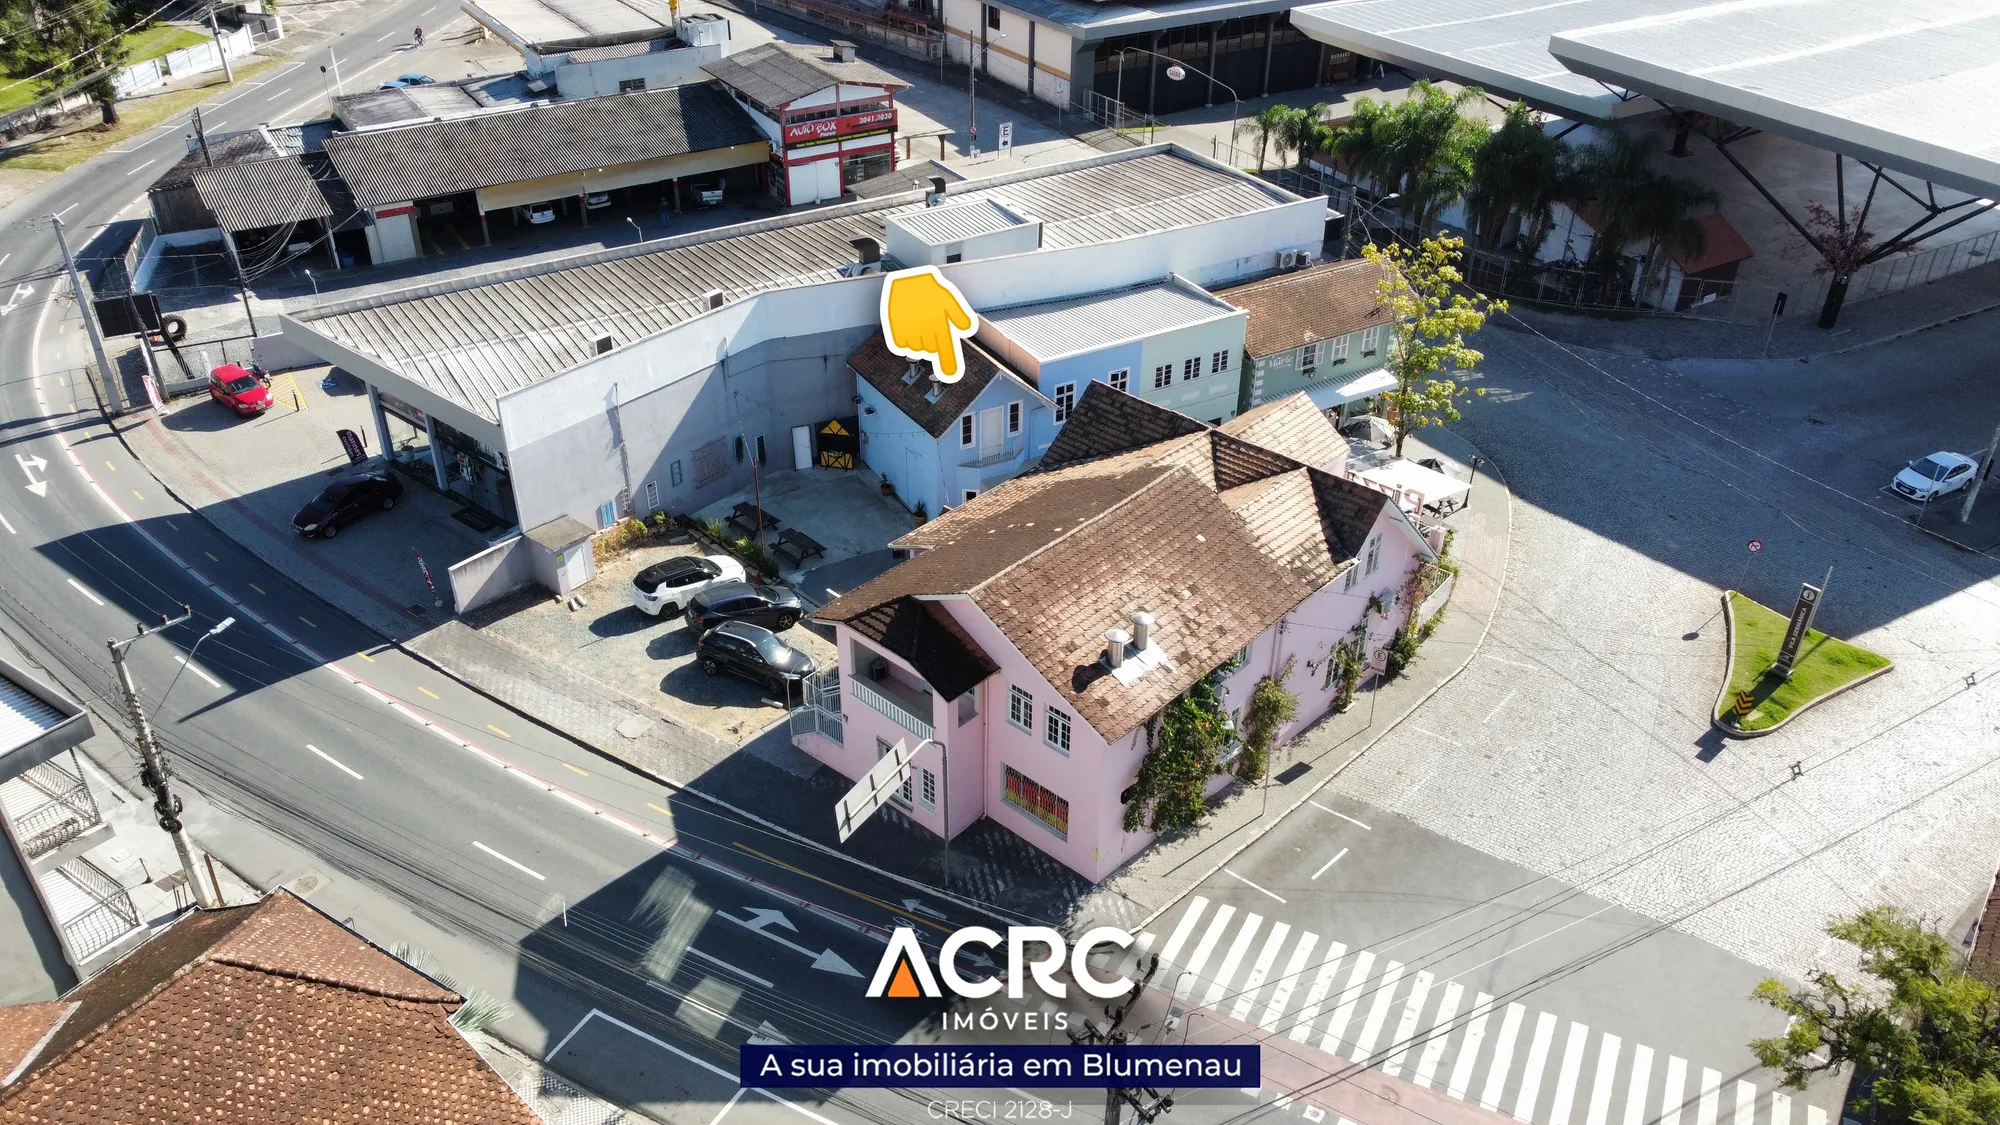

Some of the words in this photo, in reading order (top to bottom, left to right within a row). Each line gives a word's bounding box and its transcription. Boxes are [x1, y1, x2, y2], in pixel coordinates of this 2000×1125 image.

[789, 124, 814, 137] AUTO
[815, 120, 837, 134] BOX
[346, 431, 361, 457] mannes
[1788, 637, 1796, 649] VILA
